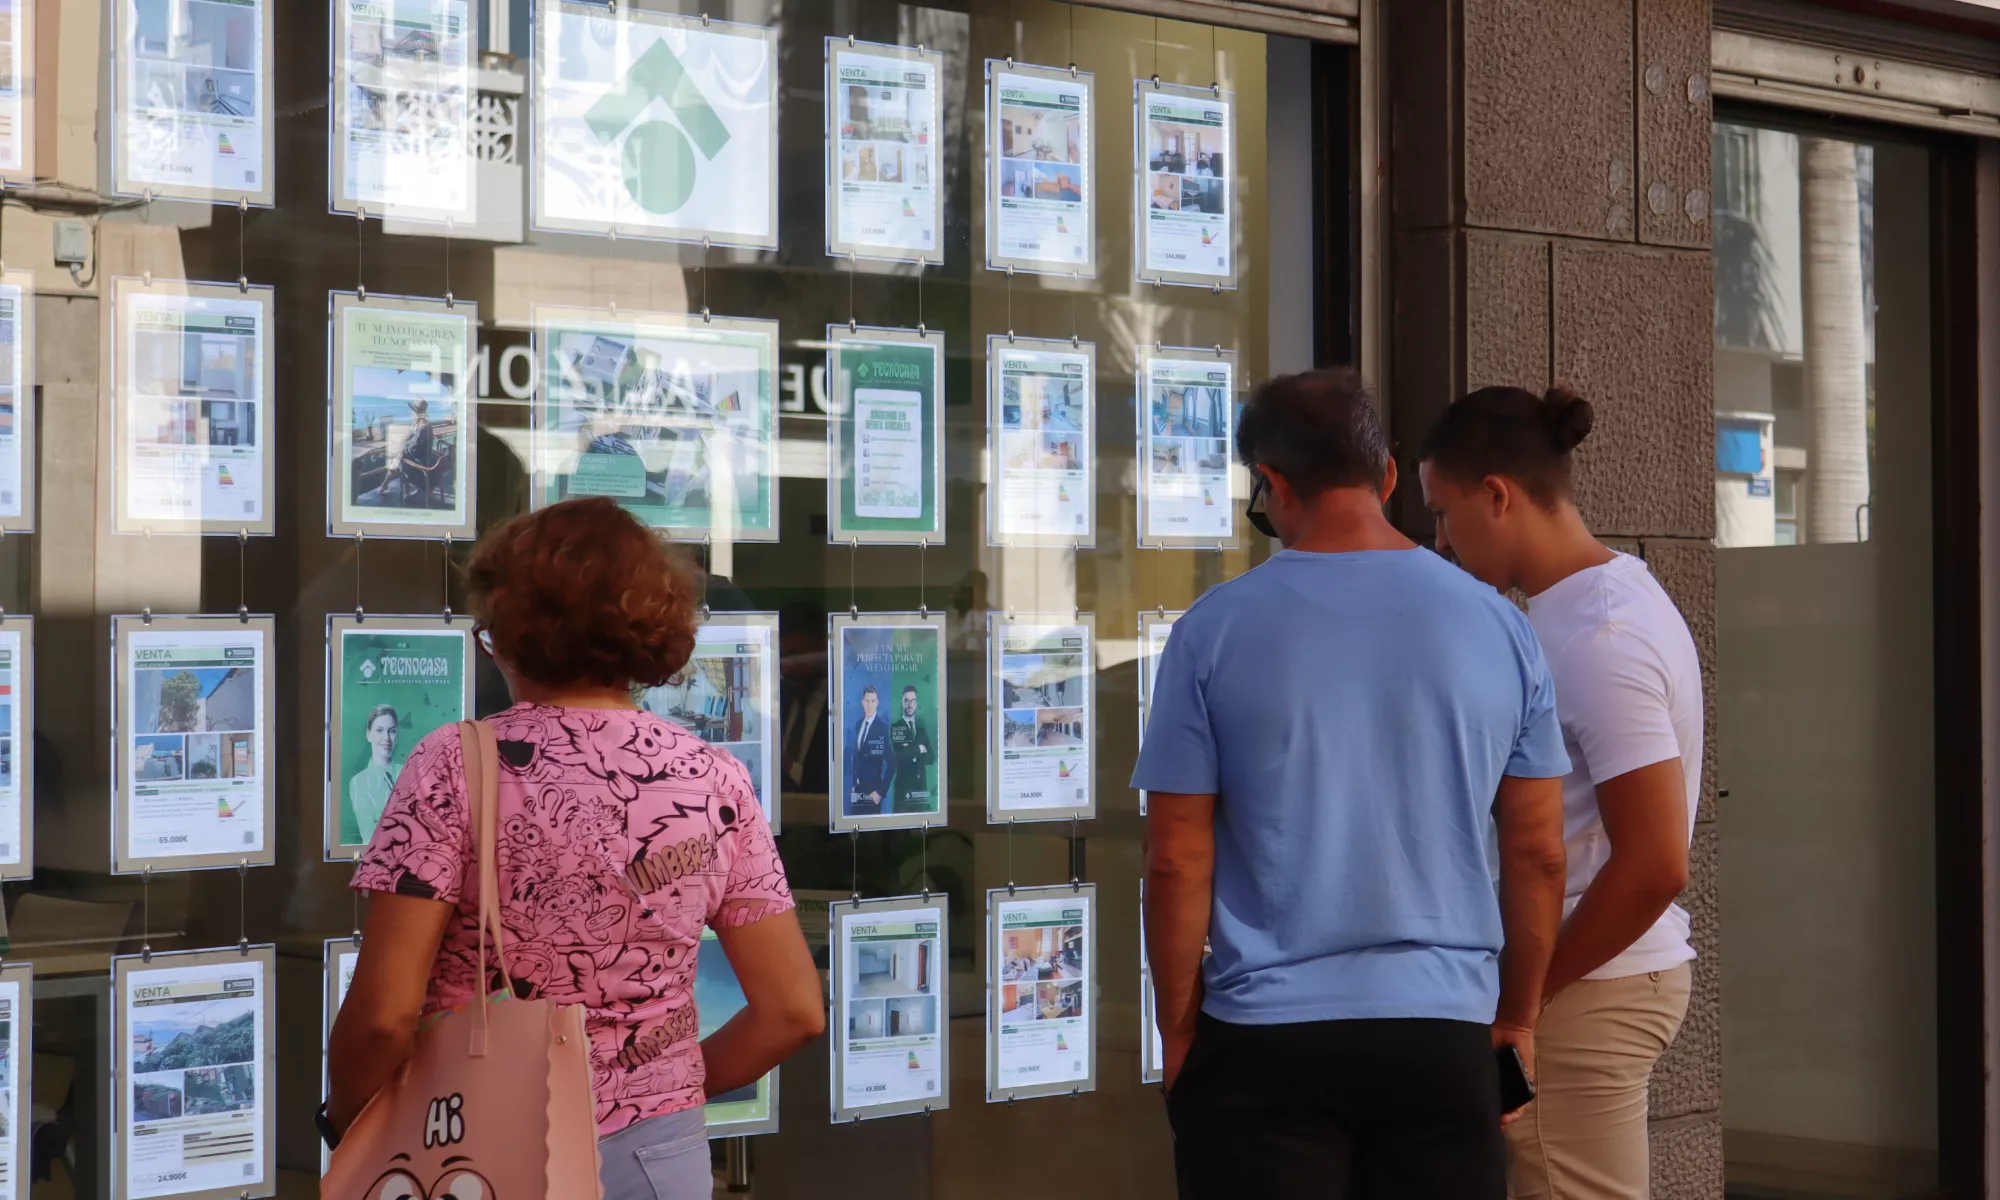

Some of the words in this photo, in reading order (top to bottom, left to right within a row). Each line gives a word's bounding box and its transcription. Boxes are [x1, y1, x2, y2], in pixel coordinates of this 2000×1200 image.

[351, 3, 386, 17] VENTA
[840, 68, 867, 78] VENTA
[1000, 89, 1025, 99] VENTA
[1149, 105, 1172, 115] VENTA
[136, 310, 173, 323] VENTA
[372, 323, 406, 336] NUEVO
[408, 326, 442, 338] HOGAR
[872, 361, 920, 379] TECNOCASA
[1003, 361, 1028, 369] VENTA
[1152, 369, 1175, 377] VENTA
[1003, 639, 1028, 648] VENTA
[135, 649, 172, 660] VENTA
[381, 656, 448, 677] TECNOCASA
[158, 835, 188, 844] 65.000€
[1003, 913, 1028, 922] VENTA
[851, 925, 878, 935] VENTA
[134, 987, 171, 999] VENTA
[424, 1092, 465, 1150] Hi
[157, 1171, 188, 1183] 24.900€
